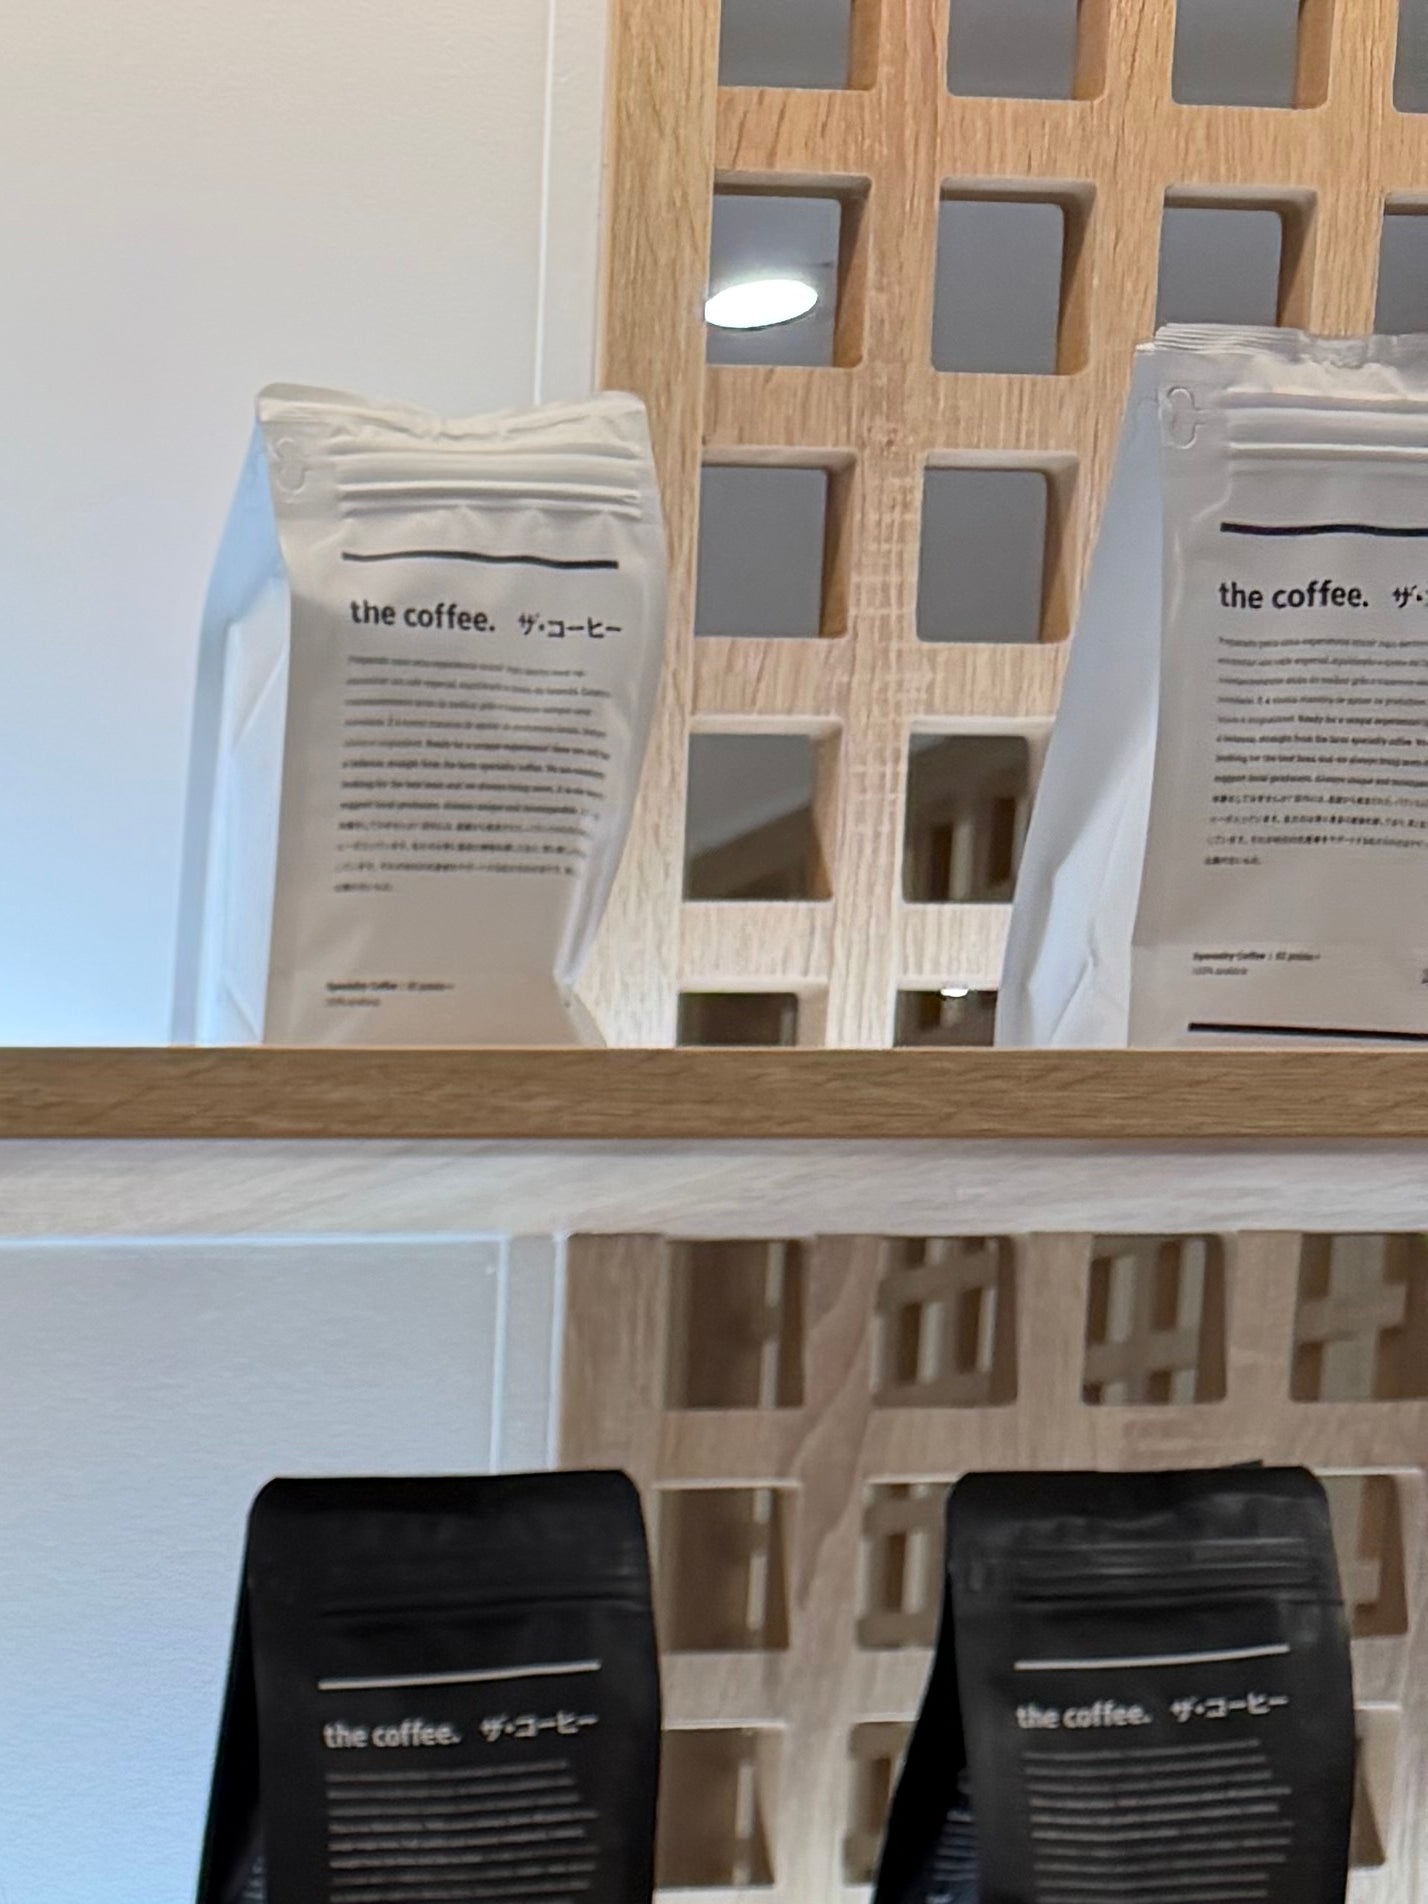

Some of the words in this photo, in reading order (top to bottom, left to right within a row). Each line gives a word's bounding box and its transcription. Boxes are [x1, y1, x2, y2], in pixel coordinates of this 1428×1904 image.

[1218, 581, 1264, 610] the
[1271, 579, 1369, 610] coffee.
[350, 600, 397, 627] the
[403, 602, 496, 633] coffee.
[1015, 1704, 1060, 1729] the
[1062, 1699, 1152, 1729] coffee.
[323, 1722, 369, 1749] the
[371, 1718, 461, 1748] coffee.
